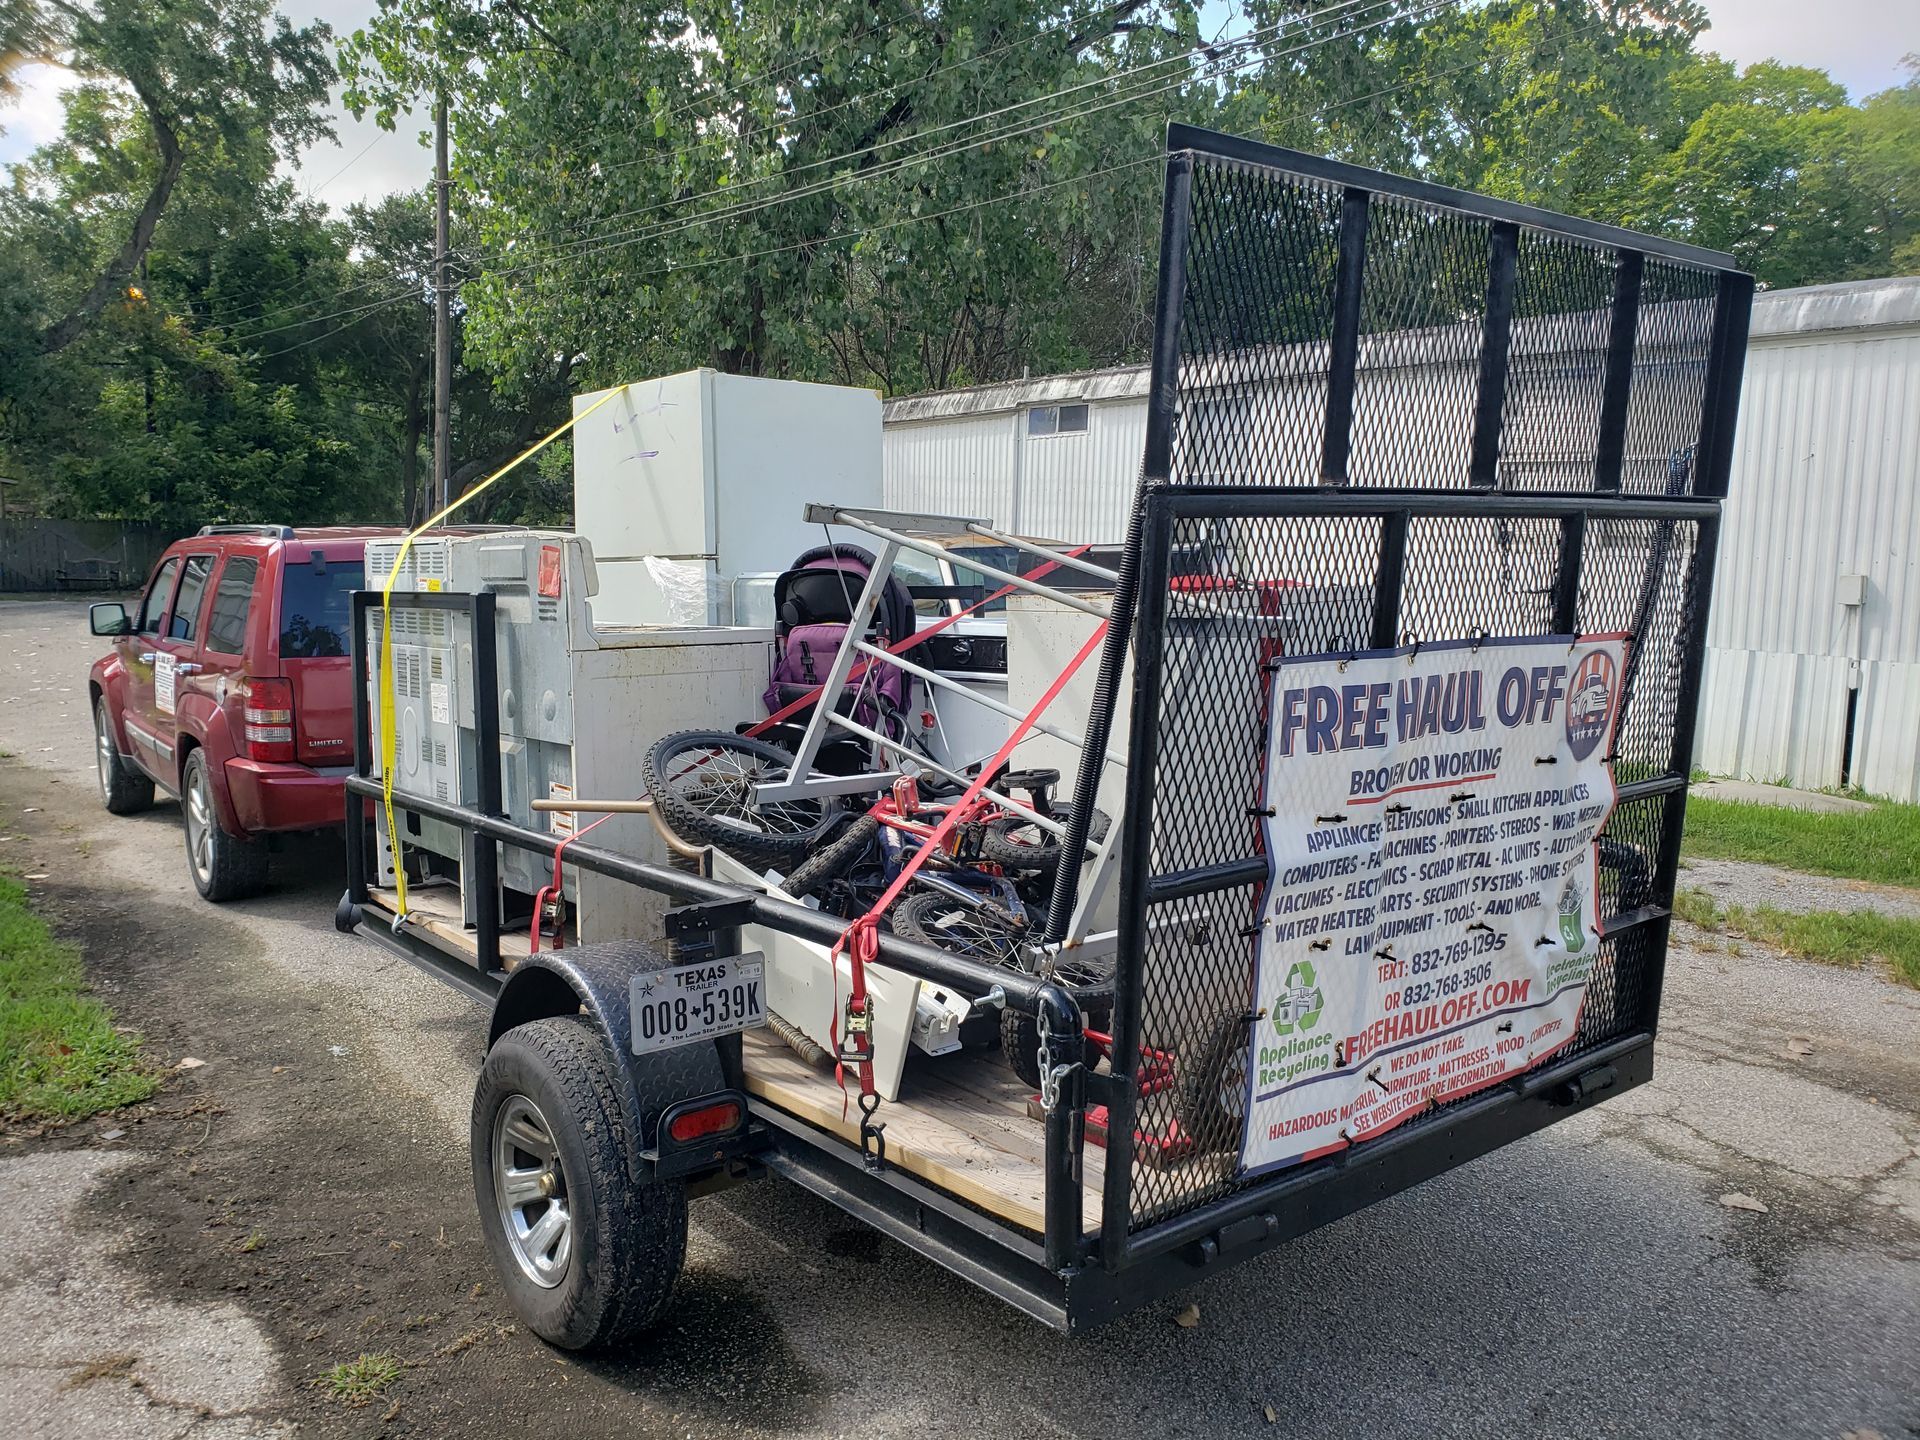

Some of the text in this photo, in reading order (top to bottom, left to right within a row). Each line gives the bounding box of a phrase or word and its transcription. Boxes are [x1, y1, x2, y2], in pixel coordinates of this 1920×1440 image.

[1280, 665, 1567, 757] FREE HAUL OFF
[309, 739, 343, 747] LIMITED
[1408, 755, 1430, 781] OR
[1434, 747, 1502, 778] WORKING
[1282, 855, 1358, 887] COMPUTERS
[1444, 824, 1494, 849] PRINTERS
[1500, 816, 1540, 839] STEREOS
[1552, 811, 1575, 830] WIRE
[1578, 804, 1604, 823] METAL
[1306, 822, 1380, 853] APPLIANCES
[1457, 799, 1490, 820] SMALL
[1492, 792, 1532, 815] KITCHEN
[1275, 886, 1334, 915] VACUMES
[1419, 860, 1453, 881] SCRAP
[1456, 852, 1491, 872] METAL
[1501, 847, 1513, 865] AC
[1514, 841, 1540, 862] UNITS
[1550, 835, 1575, 855] AUTO
[1275, 916, 1319, 943] WATER
[1320, 905, 1376, 932] HEATERS
[1423, 878, 1470, 906] SECURITY
[1472, 870, 1523, 893] SYSTEMS
[1529, 862, 1560, 884] PHONE
[1444, 901, 1475, 925] TOOLS
[1484, 898, 1512, 915] AND
[1514, 891, 1542, 912] MORE.
[674, 964, 726, 987] TEXAS
[1378, 933, 1507, 983] TEXT: 832-769-1295
[642, 982, 760, 1039] 008 539K
[685, 980, 718, 993] TRAILER
[1384, 961, 1491, 1012] OR 832-768-3506
[685, 1031, 701, 1039] Lone
[717, 1023, 734, 1031] State
[1345, 979, 1531, 1064] FREEHAULOFF.COM
[1259, 1033, 1332, 1066] Appliance
[1259, 1053, 1329, 1087] Recycling
[1391, 1035, 1465, 1073] WE DO NOT TAKE:
[1269, 1108, 1337, 1141] HAZARDOUS
[1438, 1046, 1489, 1078] MATTRESSES
[1496, 1036, 1525, 1054] WOOD
[1530, 1019, 1562, 1044] CONCRETE
[1353, 1059, 1505, 1133] SEE WEBSITE FOR MORE INFORMATION
